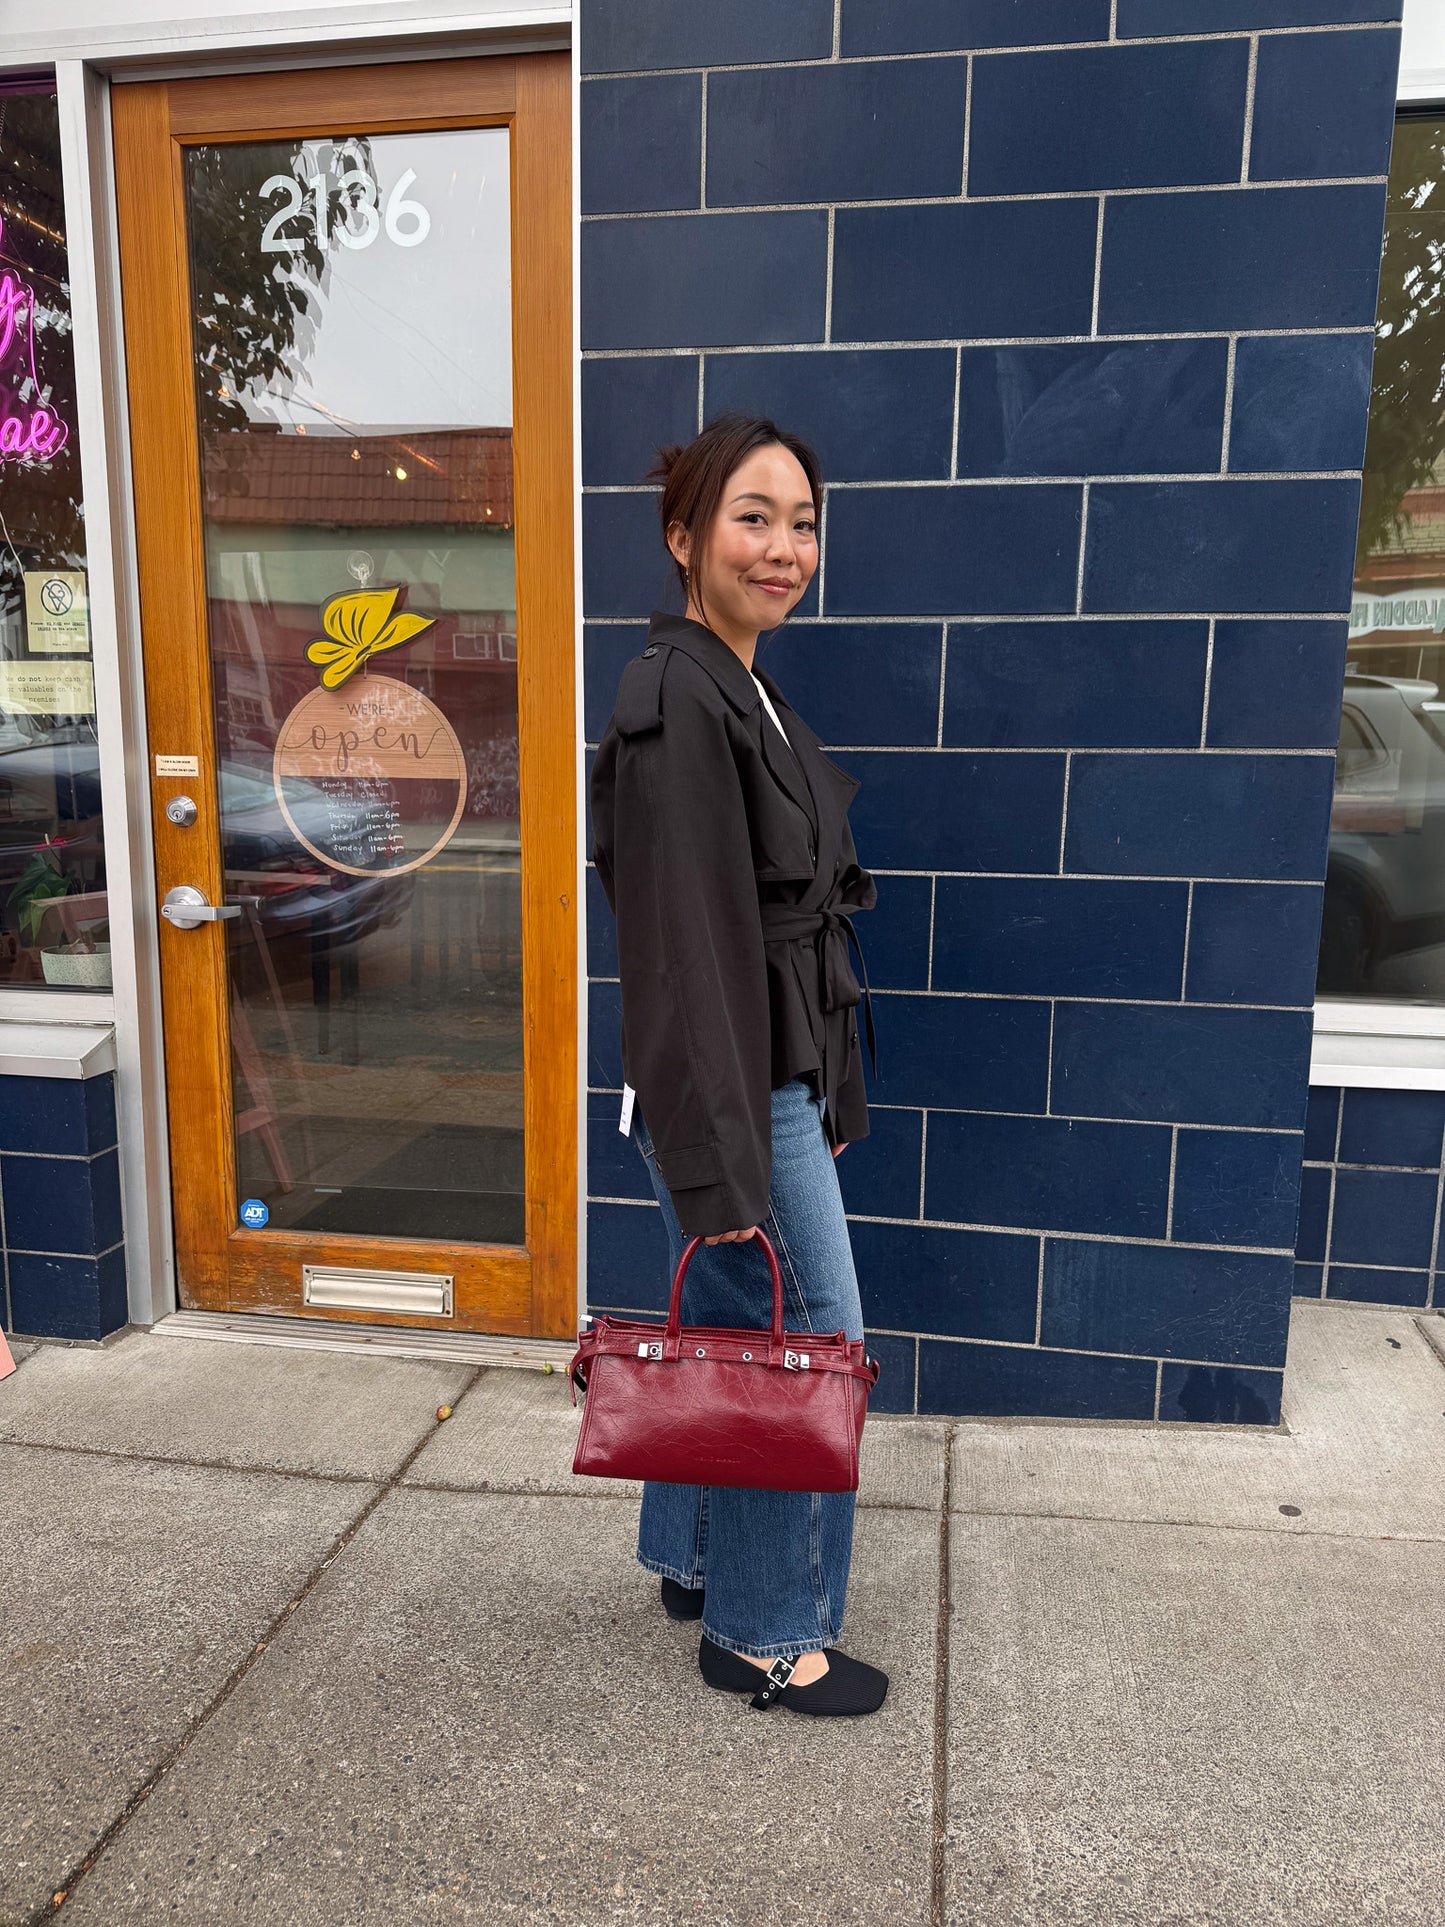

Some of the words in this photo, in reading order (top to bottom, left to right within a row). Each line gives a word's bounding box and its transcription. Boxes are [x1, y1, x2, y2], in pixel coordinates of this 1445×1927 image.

[259, 168, 431, 253] 2136
[17, 675, 26, 683] do
[29, 675, 42, 683] not
[18, 685, 54, 693] valuables
[283, 725, 445, 773] open
[322, 781, 347, 790] Monday
[325, 791, 353, 800] Tuesday
[333, 844, 363, 855] Sunday
[244, 1207, 265, 1218] ADT
